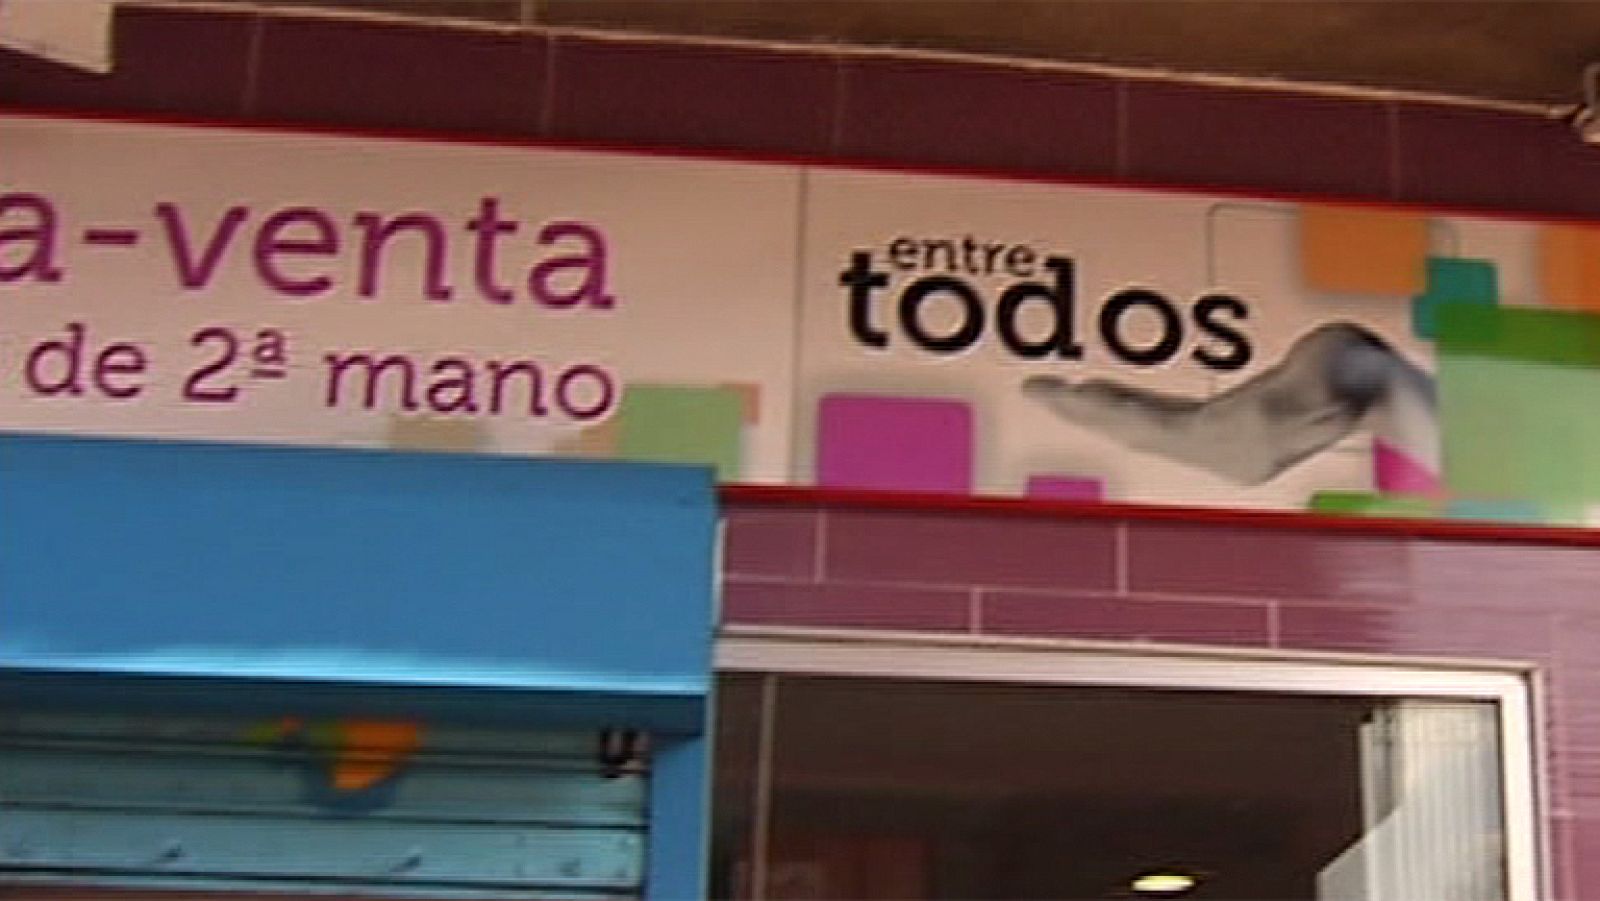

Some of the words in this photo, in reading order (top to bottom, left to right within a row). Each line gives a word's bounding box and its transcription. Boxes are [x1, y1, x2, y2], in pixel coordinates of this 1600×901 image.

[0, 192, 615, 310] a-venta
[889, 234, 1036, 277] entre
[839, 250, 1253, 371] todos
[25, 322, 147, 398] de
[182, 327, 287, 402] 2ª
[323, 352, 616, 420] mano
